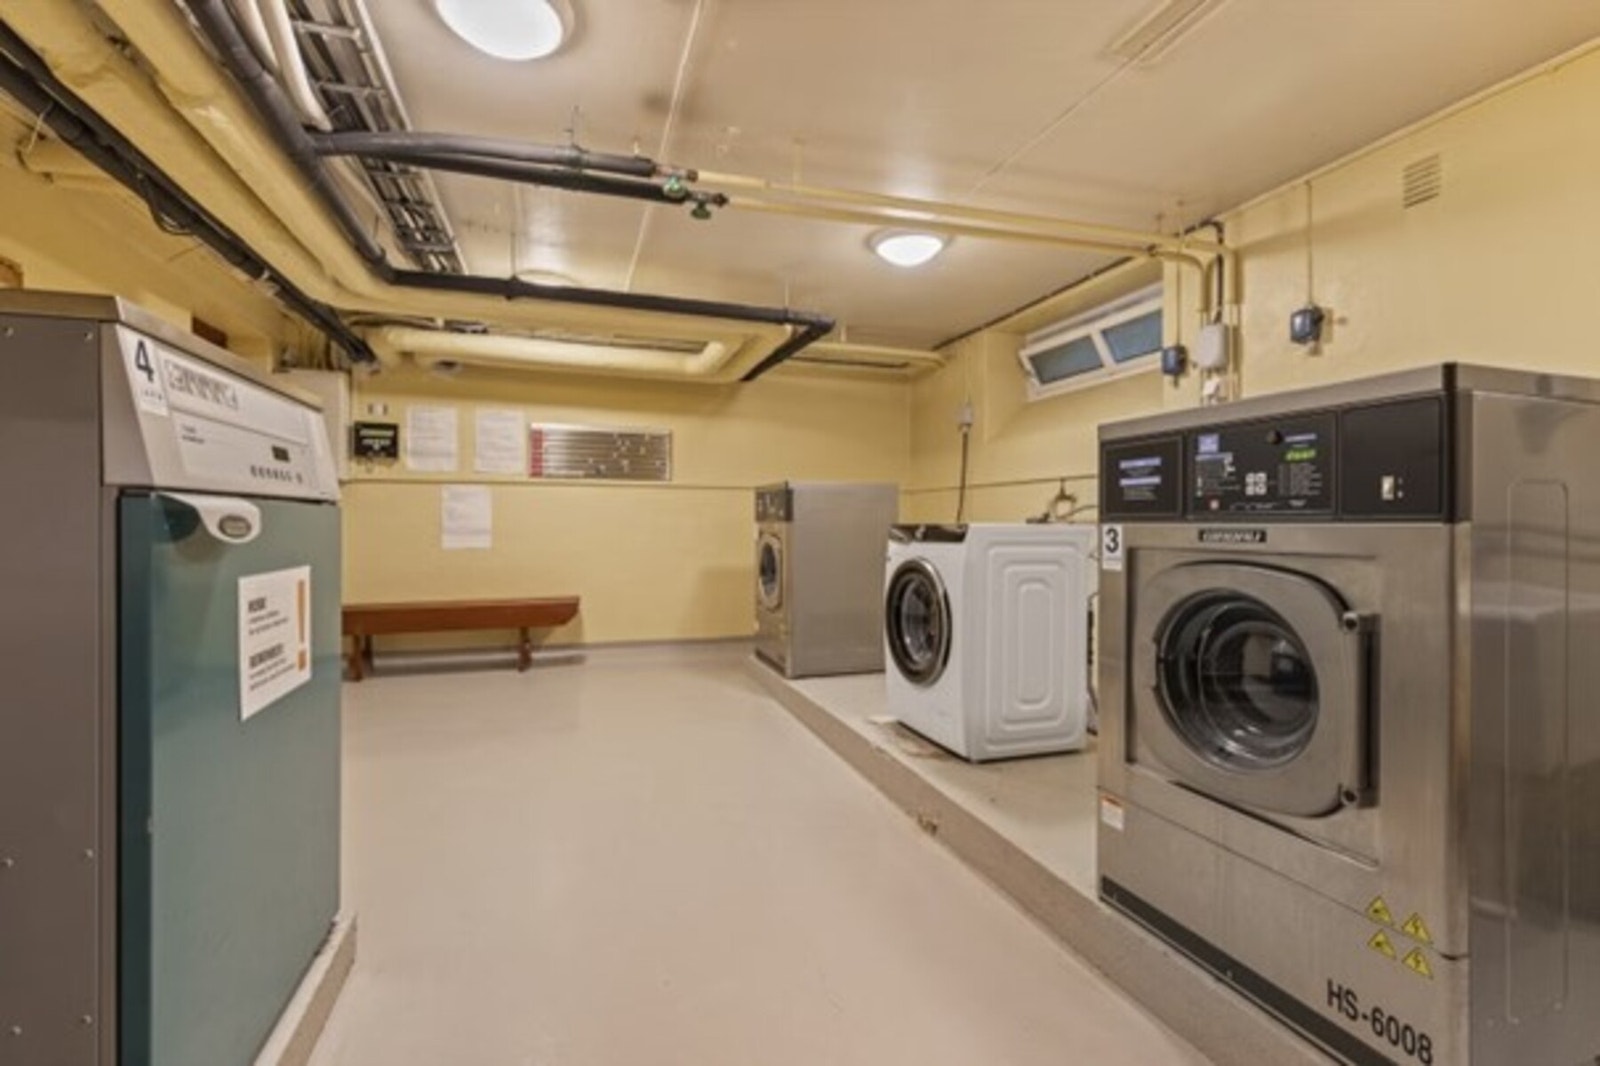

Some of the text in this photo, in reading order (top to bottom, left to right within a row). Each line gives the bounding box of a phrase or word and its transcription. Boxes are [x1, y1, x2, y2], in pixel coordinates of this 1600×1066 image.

[135, 339, 154, 382] 4
[1105, 527, 1119, 553] 3
[1327, 979, 1433, 1066] HS-6008
